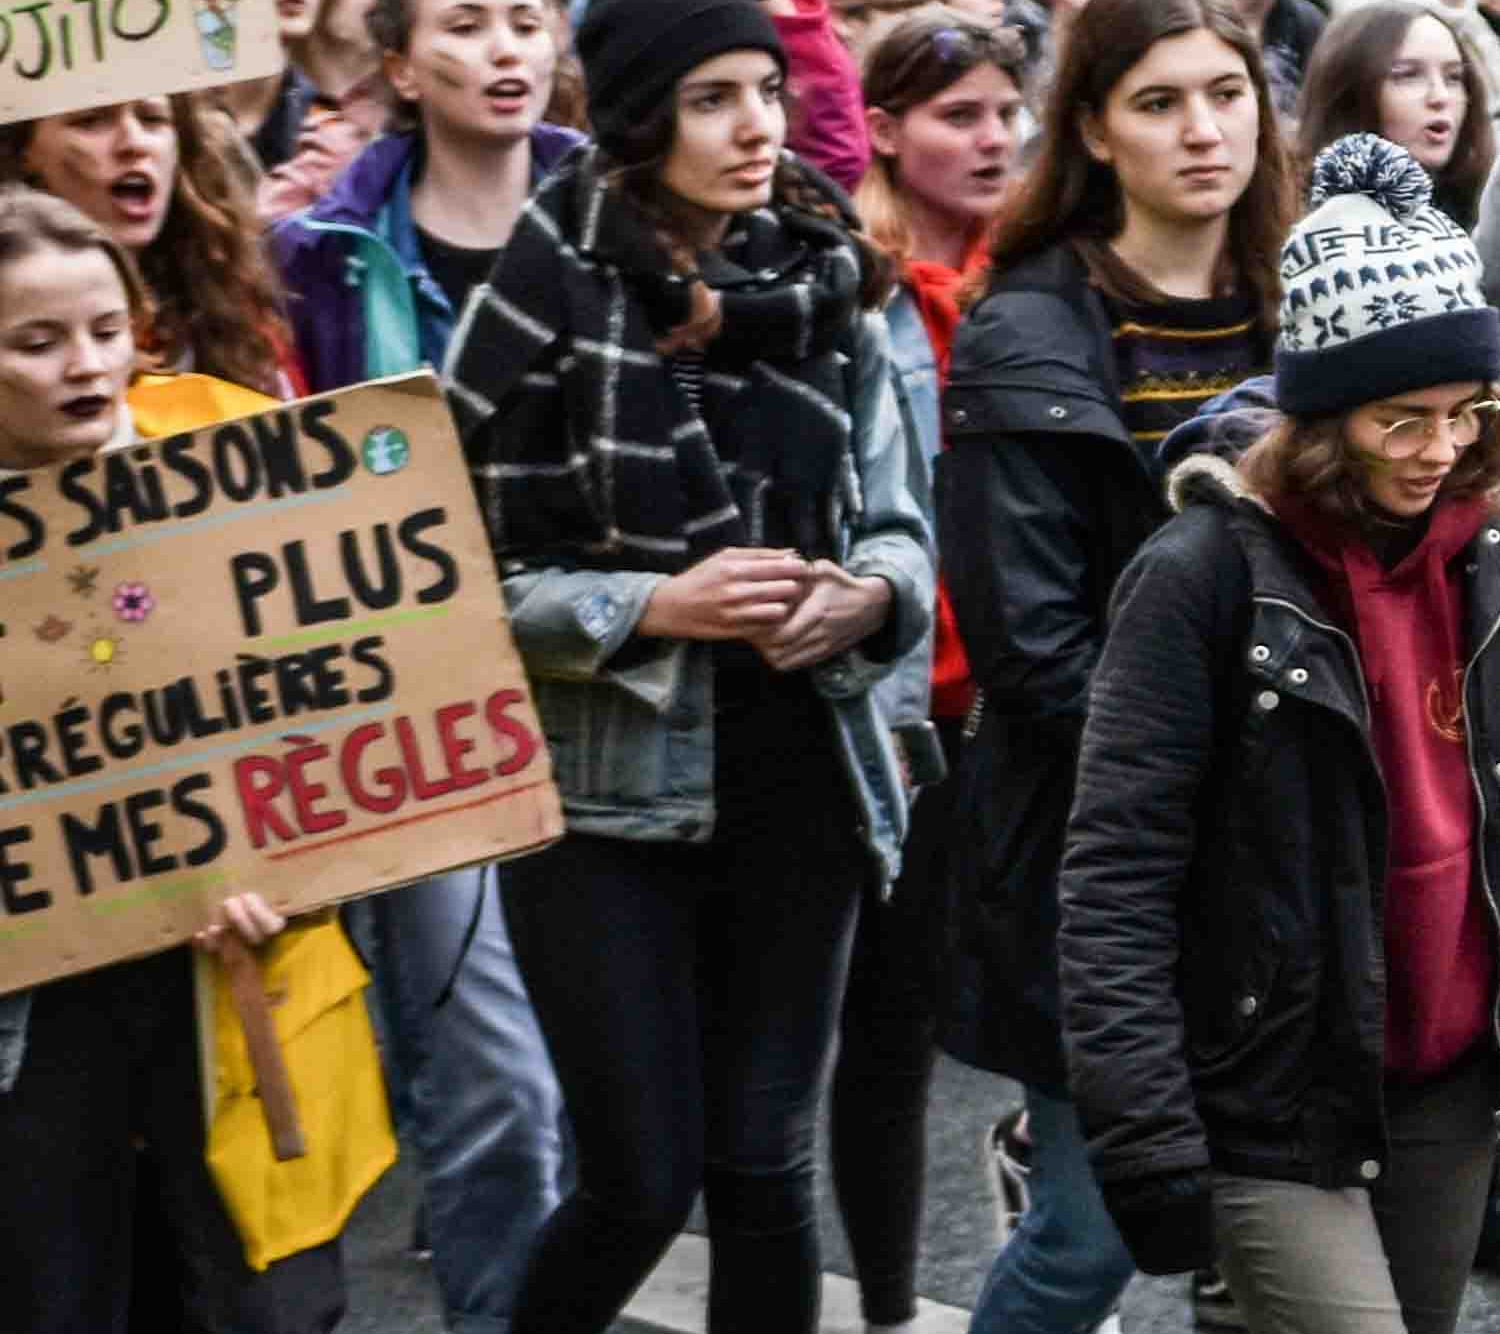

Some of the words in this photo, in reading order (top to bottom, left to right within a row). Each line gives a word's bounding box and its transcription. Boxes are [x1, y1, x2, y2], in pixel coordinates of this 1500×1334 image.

[230, 507, 459, 637] PLUS
[59, 773, 228, 896] MES
[233, 687, 543, 850] RÈGLES
